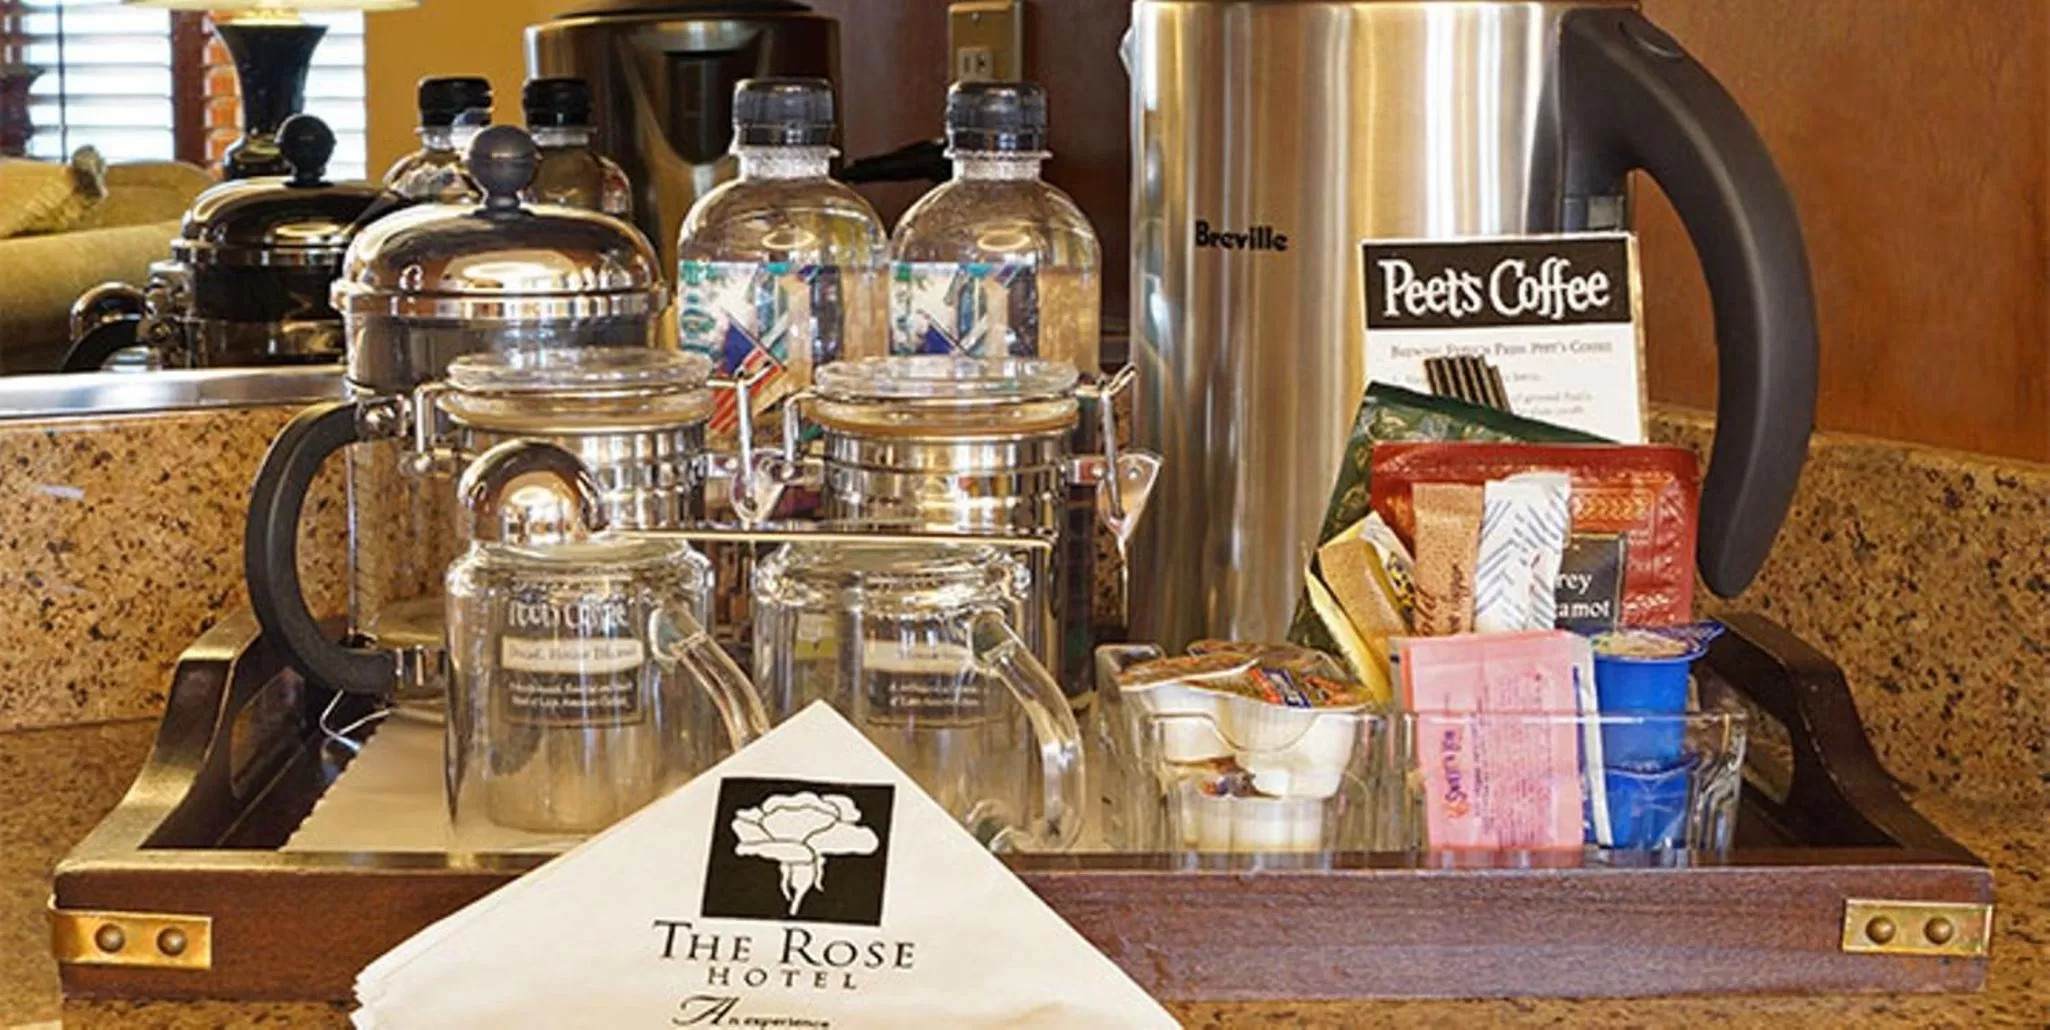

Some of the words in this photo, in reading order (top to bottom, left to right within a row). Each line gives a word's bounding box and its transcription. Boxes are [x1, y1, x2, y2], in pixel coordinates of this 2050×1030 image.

[1195, 219, 1289, 252] Breville
[1377, 258, 1483, 318] Peet's
[1489, 256, 1611, 320] Coffee
[1556, 571, 1592, 595] rey
[1557, 600, 1610, 618] amot
[707, 965, 858, 990] HOTEL
[743, 1015, 831, 1030] experience
